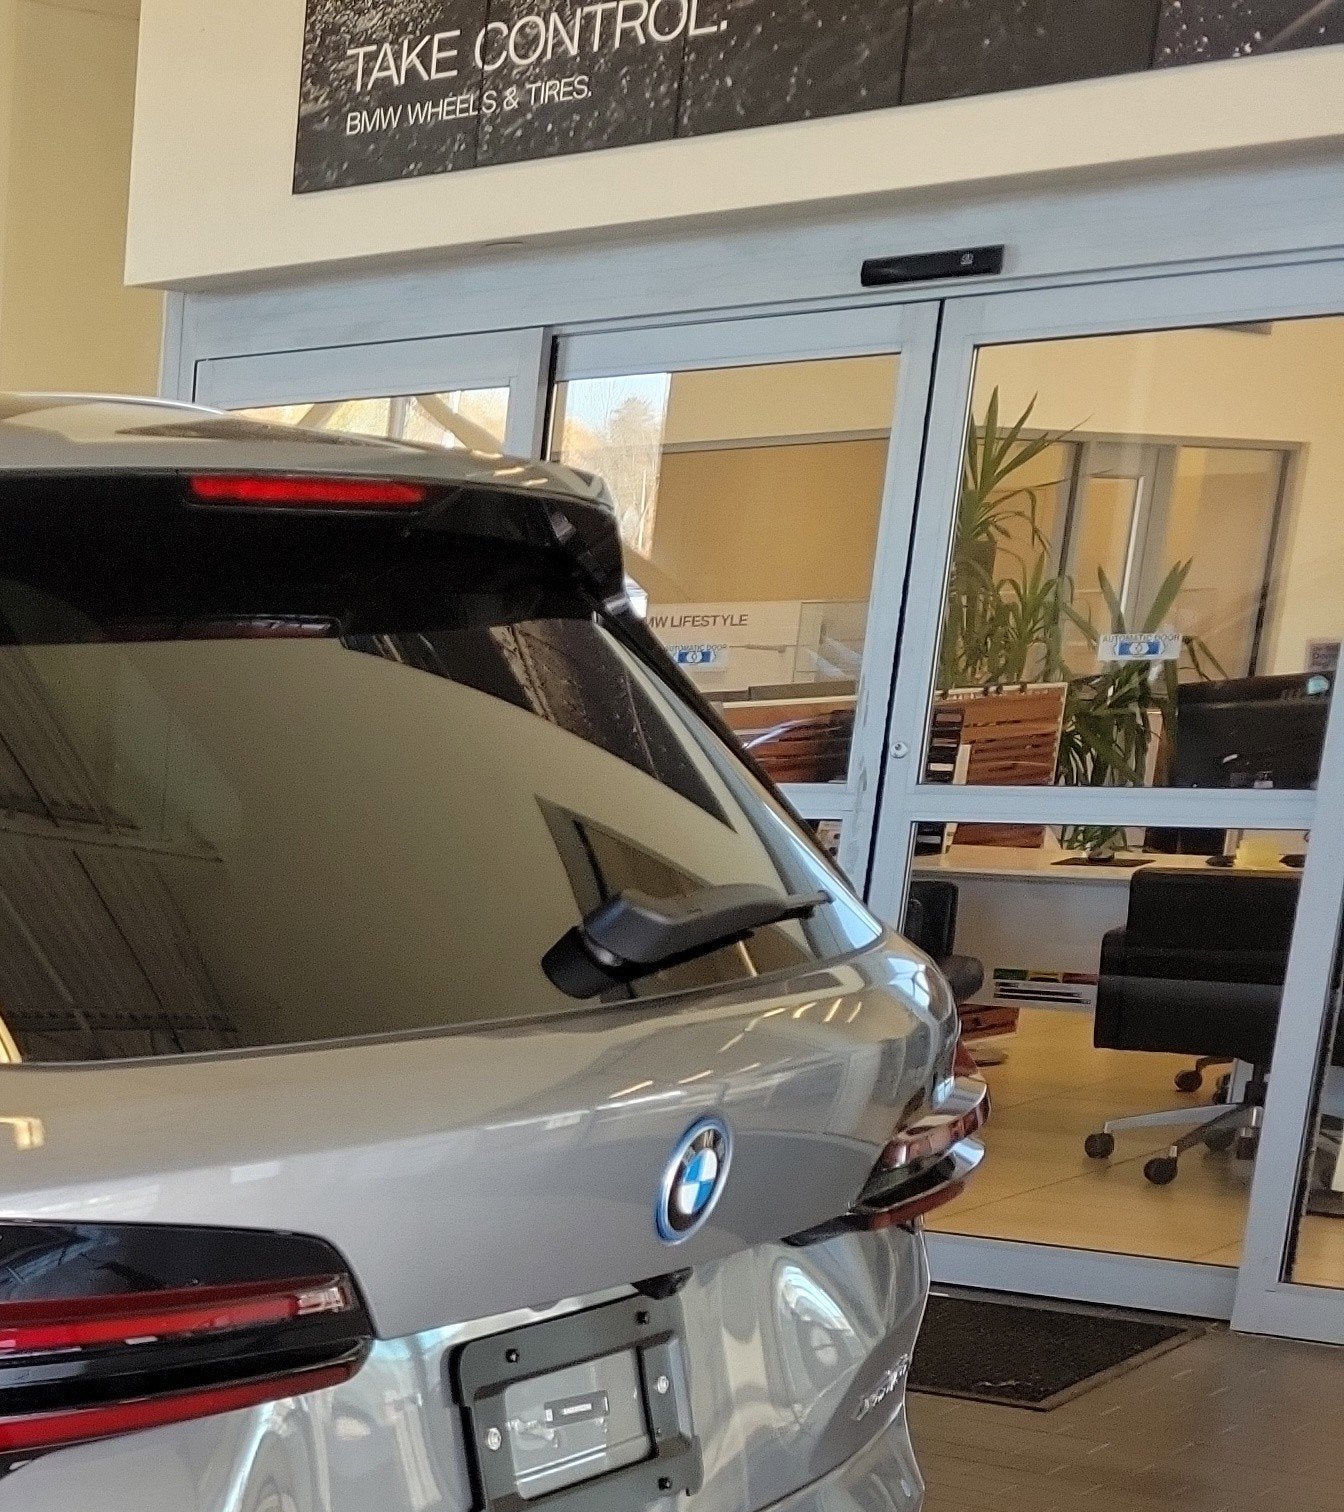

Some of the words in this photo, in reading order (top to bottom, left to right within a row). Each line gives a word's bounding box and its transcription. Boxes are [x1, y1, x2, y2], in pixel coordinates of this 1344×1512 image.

[346, 31, 460, 93] TAKE
[475, 0, 728, 71] CONTROL.
[346, 104, 403, 136] BMW
[407, 90, 499, 125] WHEELS
[502, 86, 520, 109] &
[527, 75, 593, 107] TIRES.
[670, 614, 749, 628] LIFESTYLE
